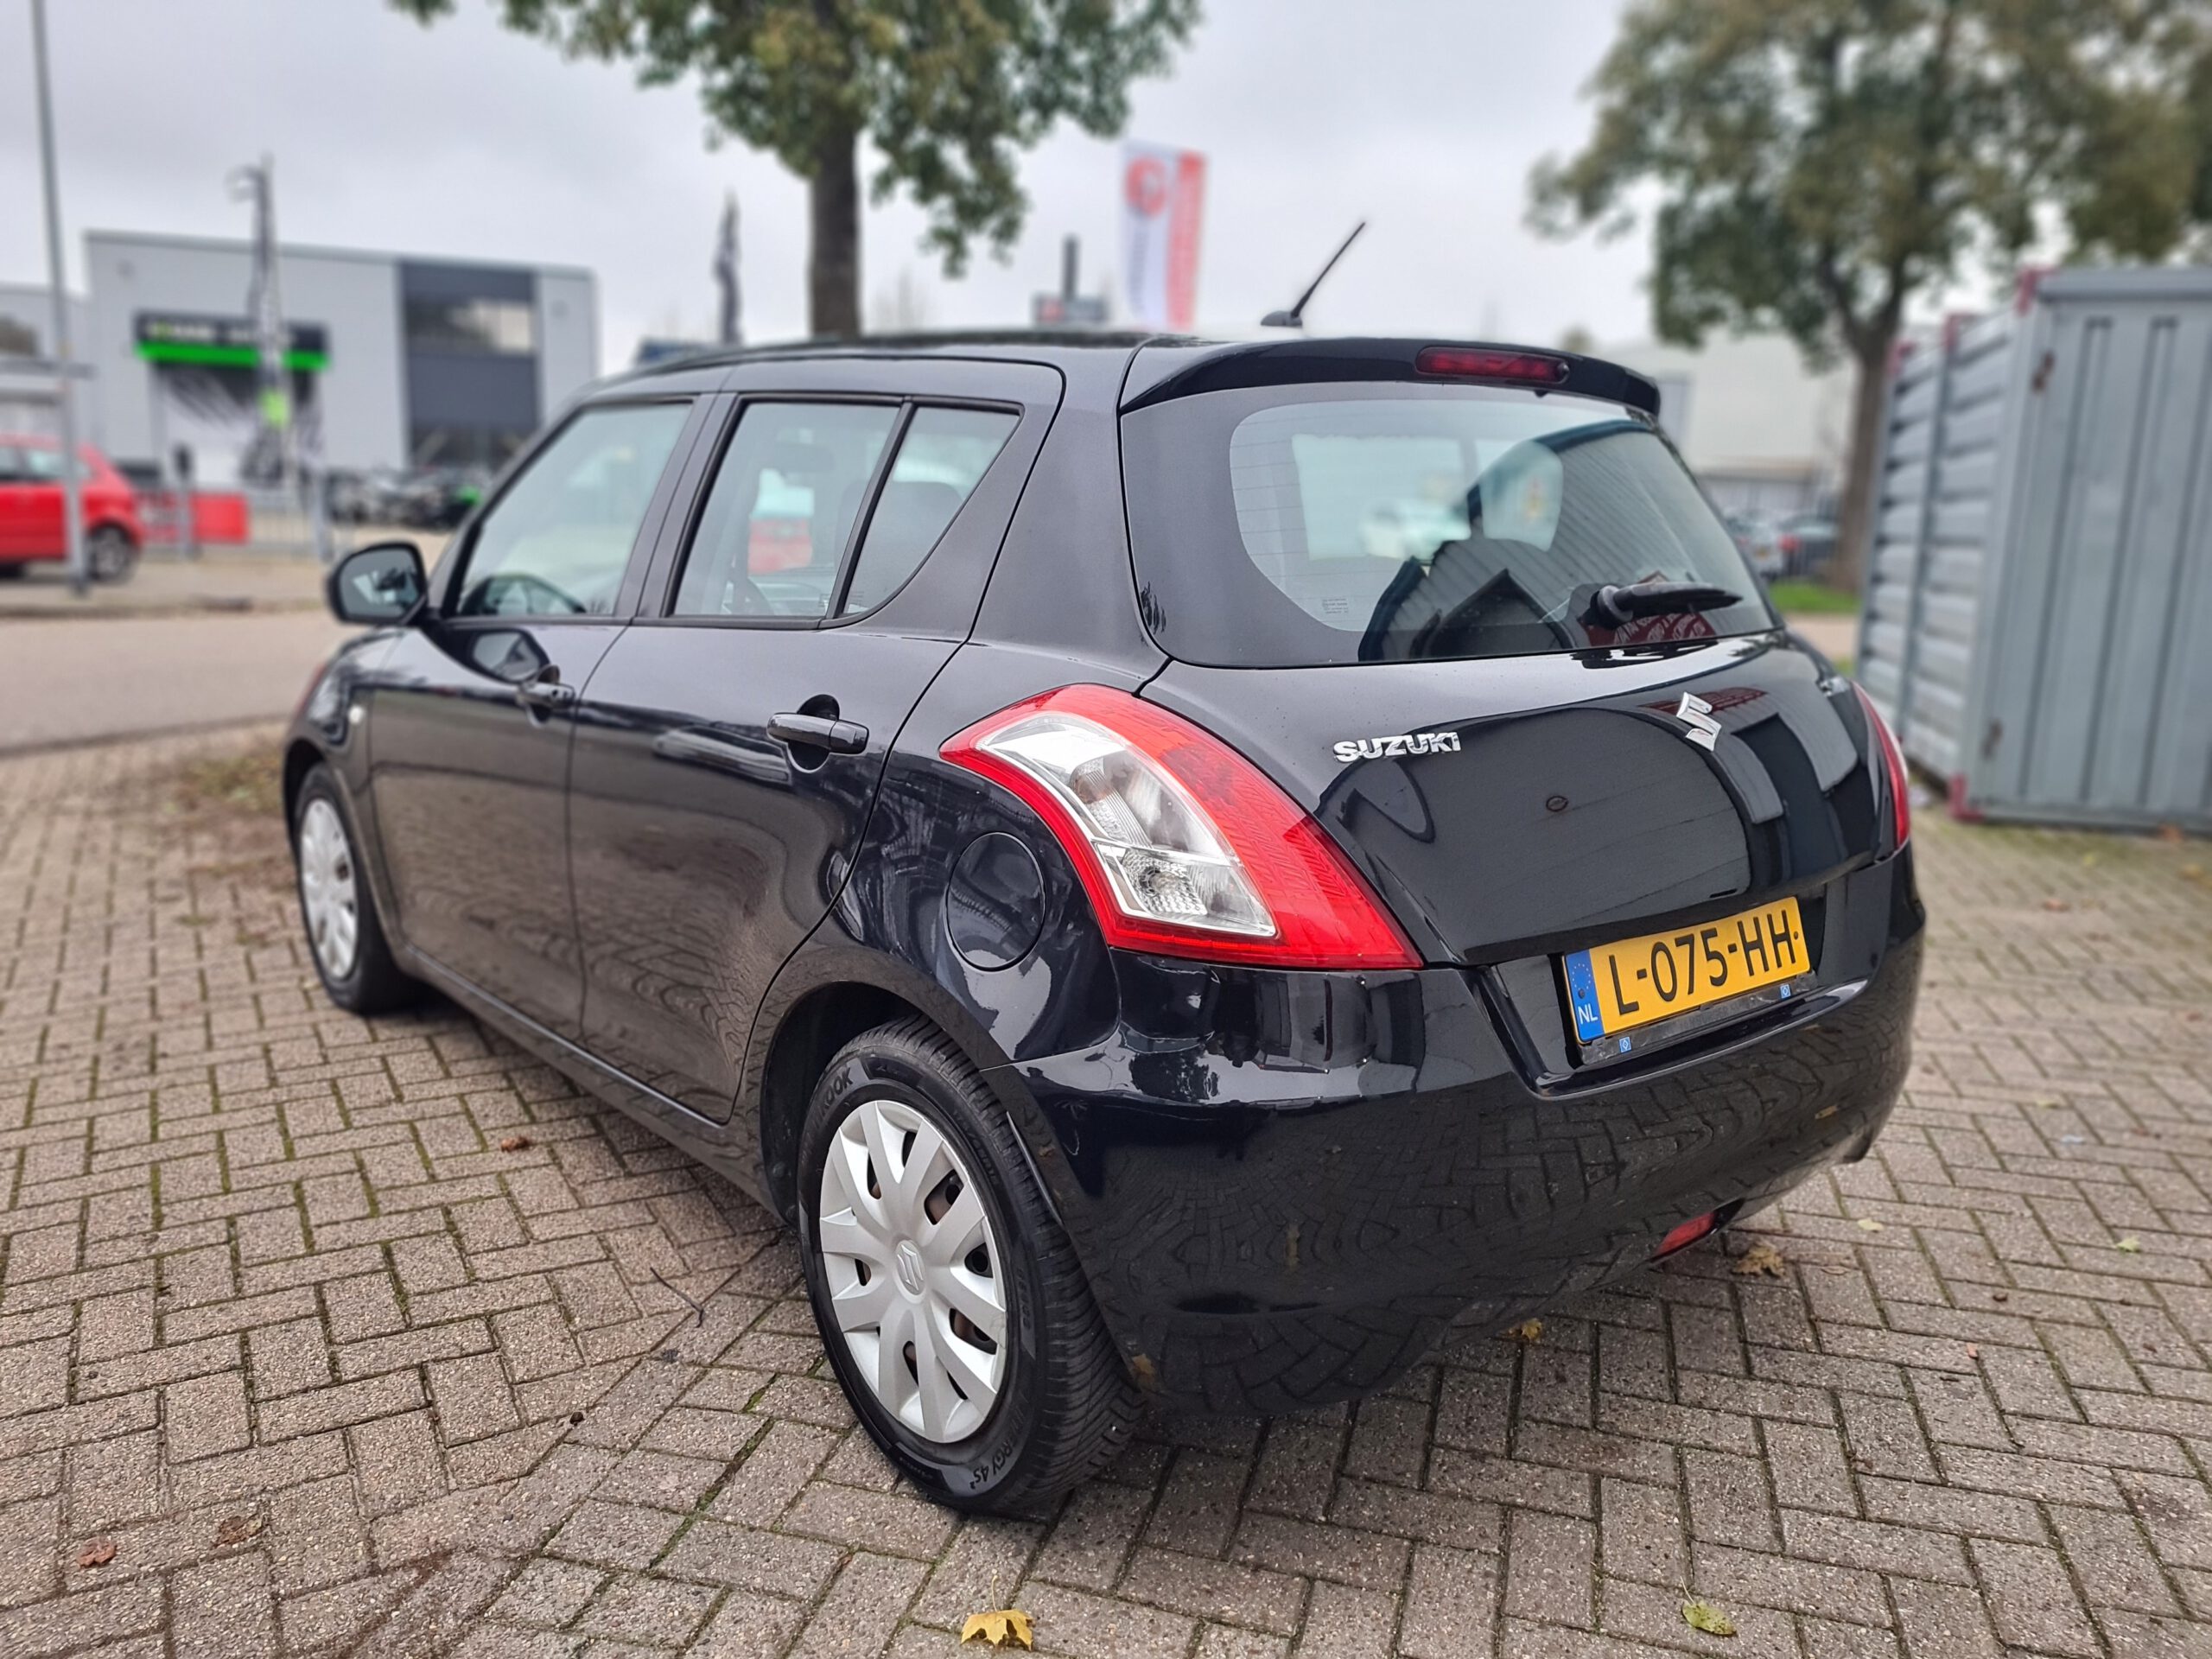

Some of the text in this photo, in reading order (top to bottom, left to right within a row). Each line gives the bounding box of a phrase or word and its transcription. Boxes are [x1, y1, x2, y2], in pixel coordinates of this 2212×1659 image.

[1333, 732, 1461, 762] SUZUKI
[1608, 909, 1796, 1016] L-075-HH
[1577, 1004, 1599, 1025] NL
